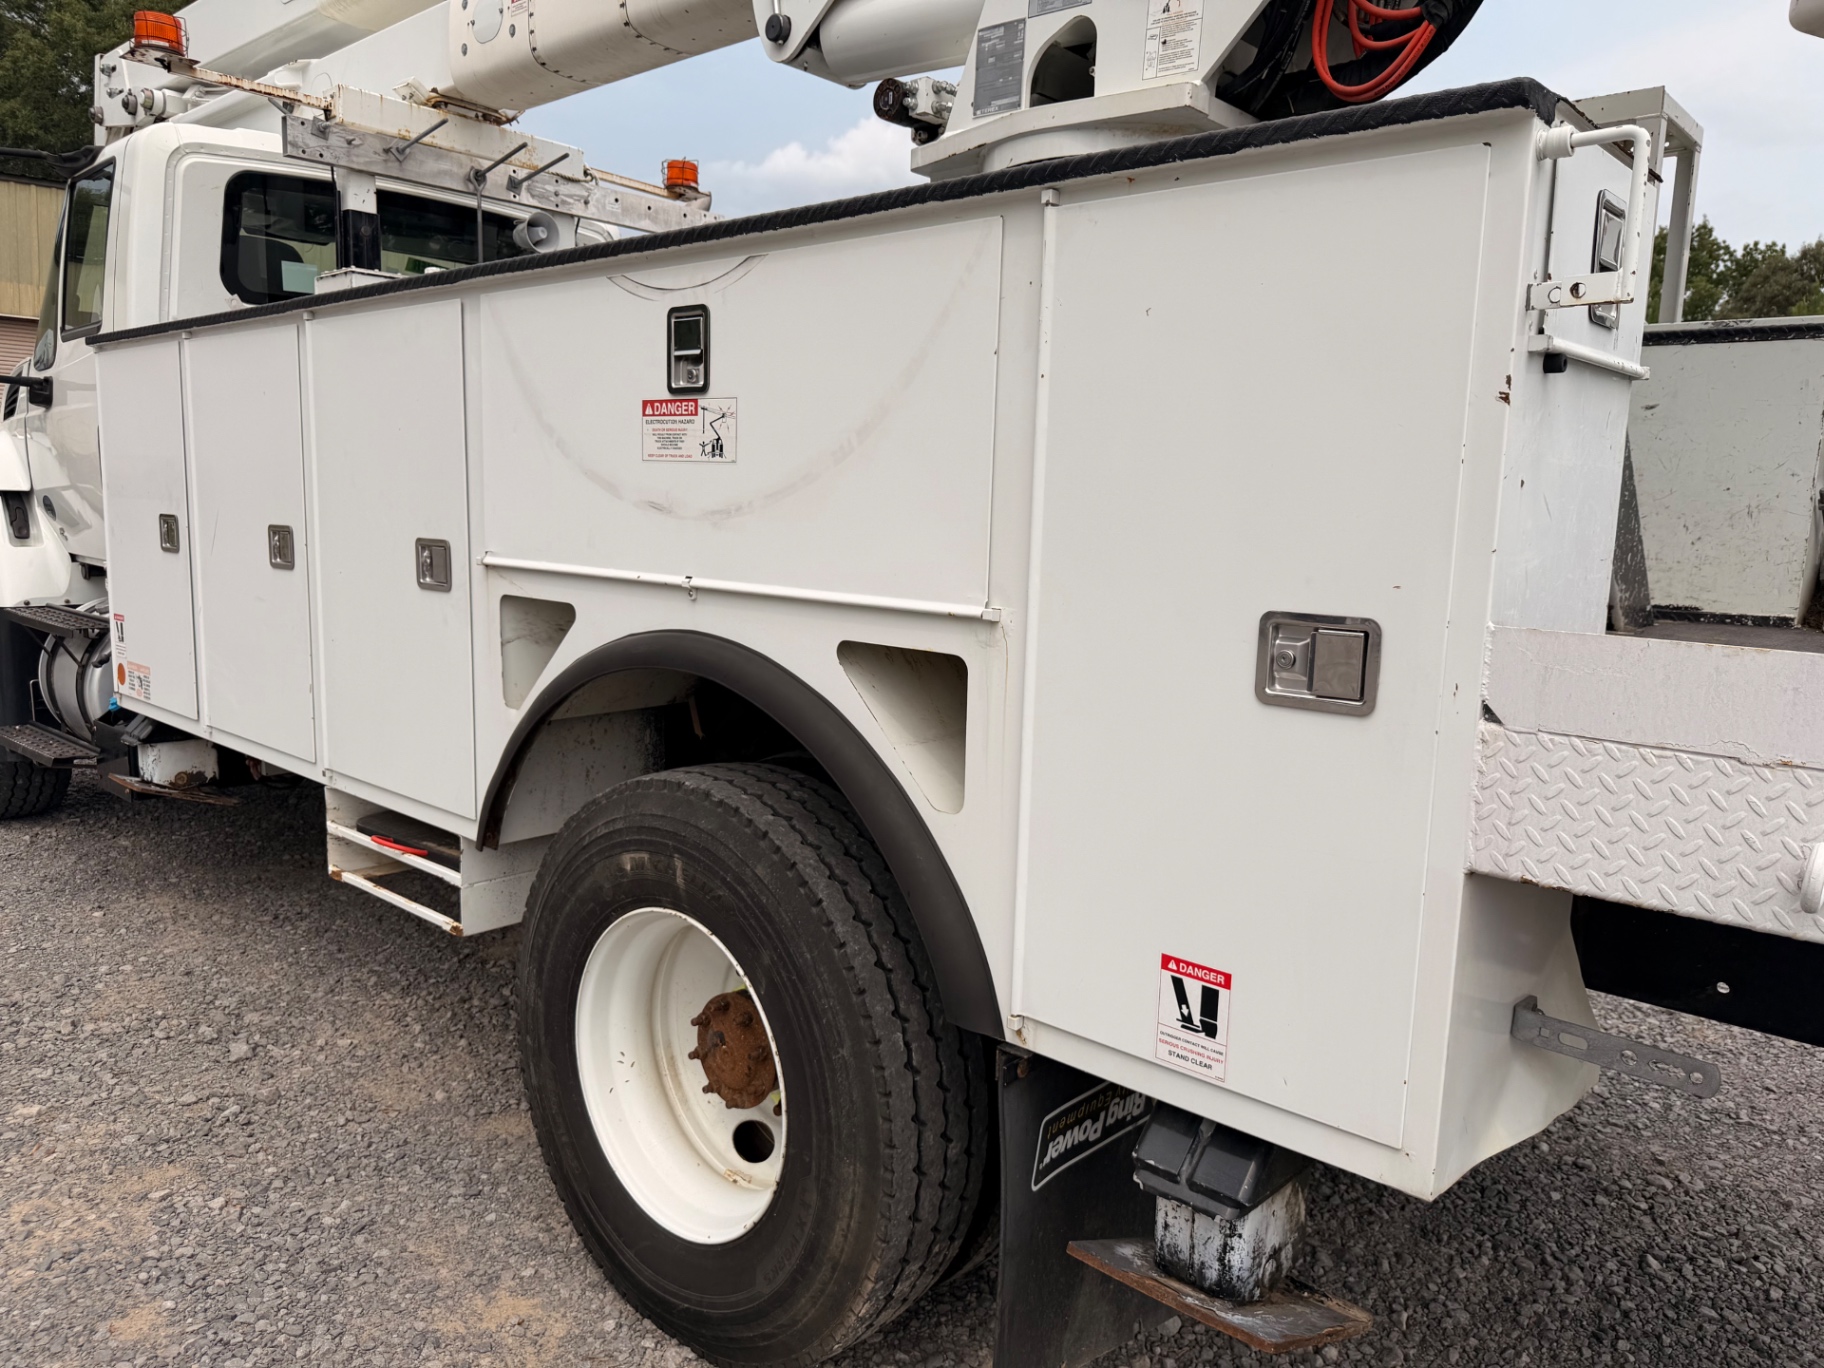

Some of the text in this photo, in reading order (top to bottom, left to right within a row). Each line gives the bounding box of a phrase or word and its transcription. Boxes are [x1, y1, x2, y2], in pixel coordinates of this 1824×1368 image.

[981, 106, 999, 114] TEREX
[654, 401, 695, 415] DANGER
[1179, 962, 1225, 985] DANGER
[1159, 1038, 1223, 1064] SERIOUS CRUSHING INJURY
[1160, 1031, 1181, 1041] OUTRIGGER
[1182, 1038, 1200, 1047] CONTACT
[1210, 1048, 1224, 1056] CAUSE
[1168, 1050, 1212, 1070] STAND CLEAR
[1047, 1090, 1113, 1139] Equipment
[1042, 1092, 1147, 1167] Ring Power
